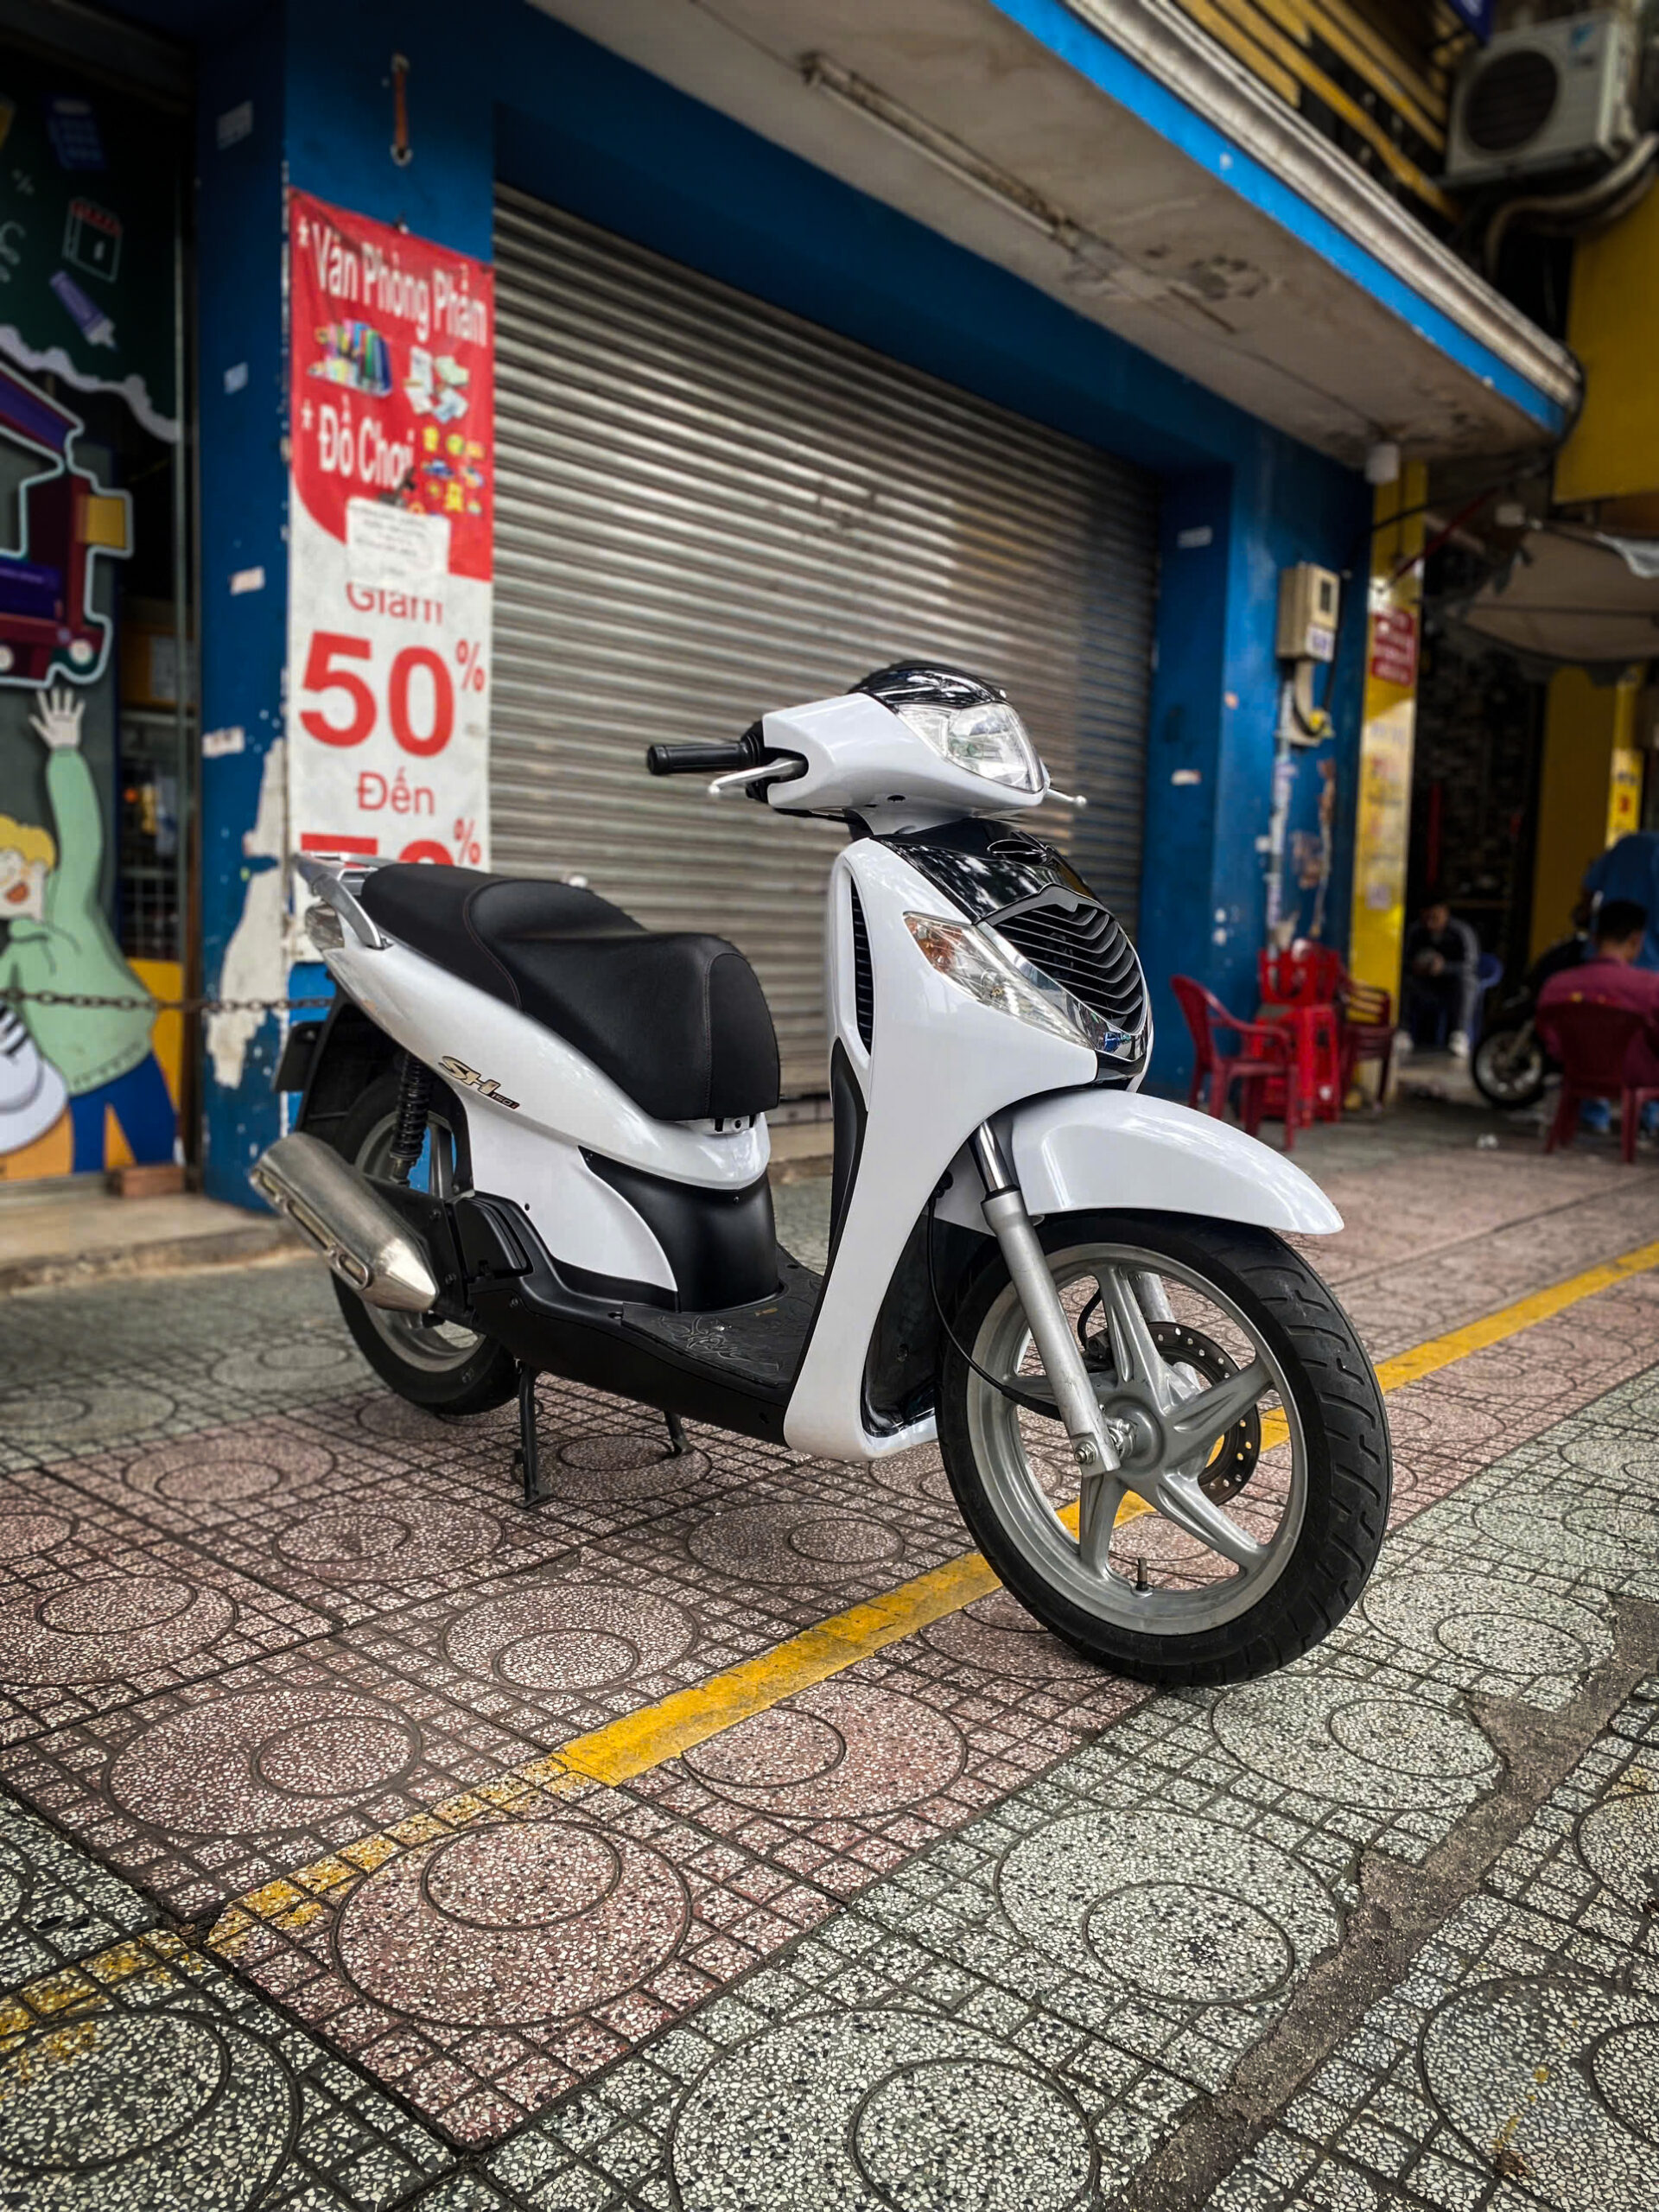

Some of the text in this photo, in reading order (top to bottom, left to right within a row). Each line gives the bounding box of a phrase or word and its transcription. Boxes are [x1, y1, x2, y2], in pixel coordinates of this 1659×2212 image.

[312, 221, 488, 347] Văn Phòng Phẩm
[318, 392, 354, 479] Đồ
[299, 630, 486, 759] 50%
[356, 766, 436, 817] Đến
